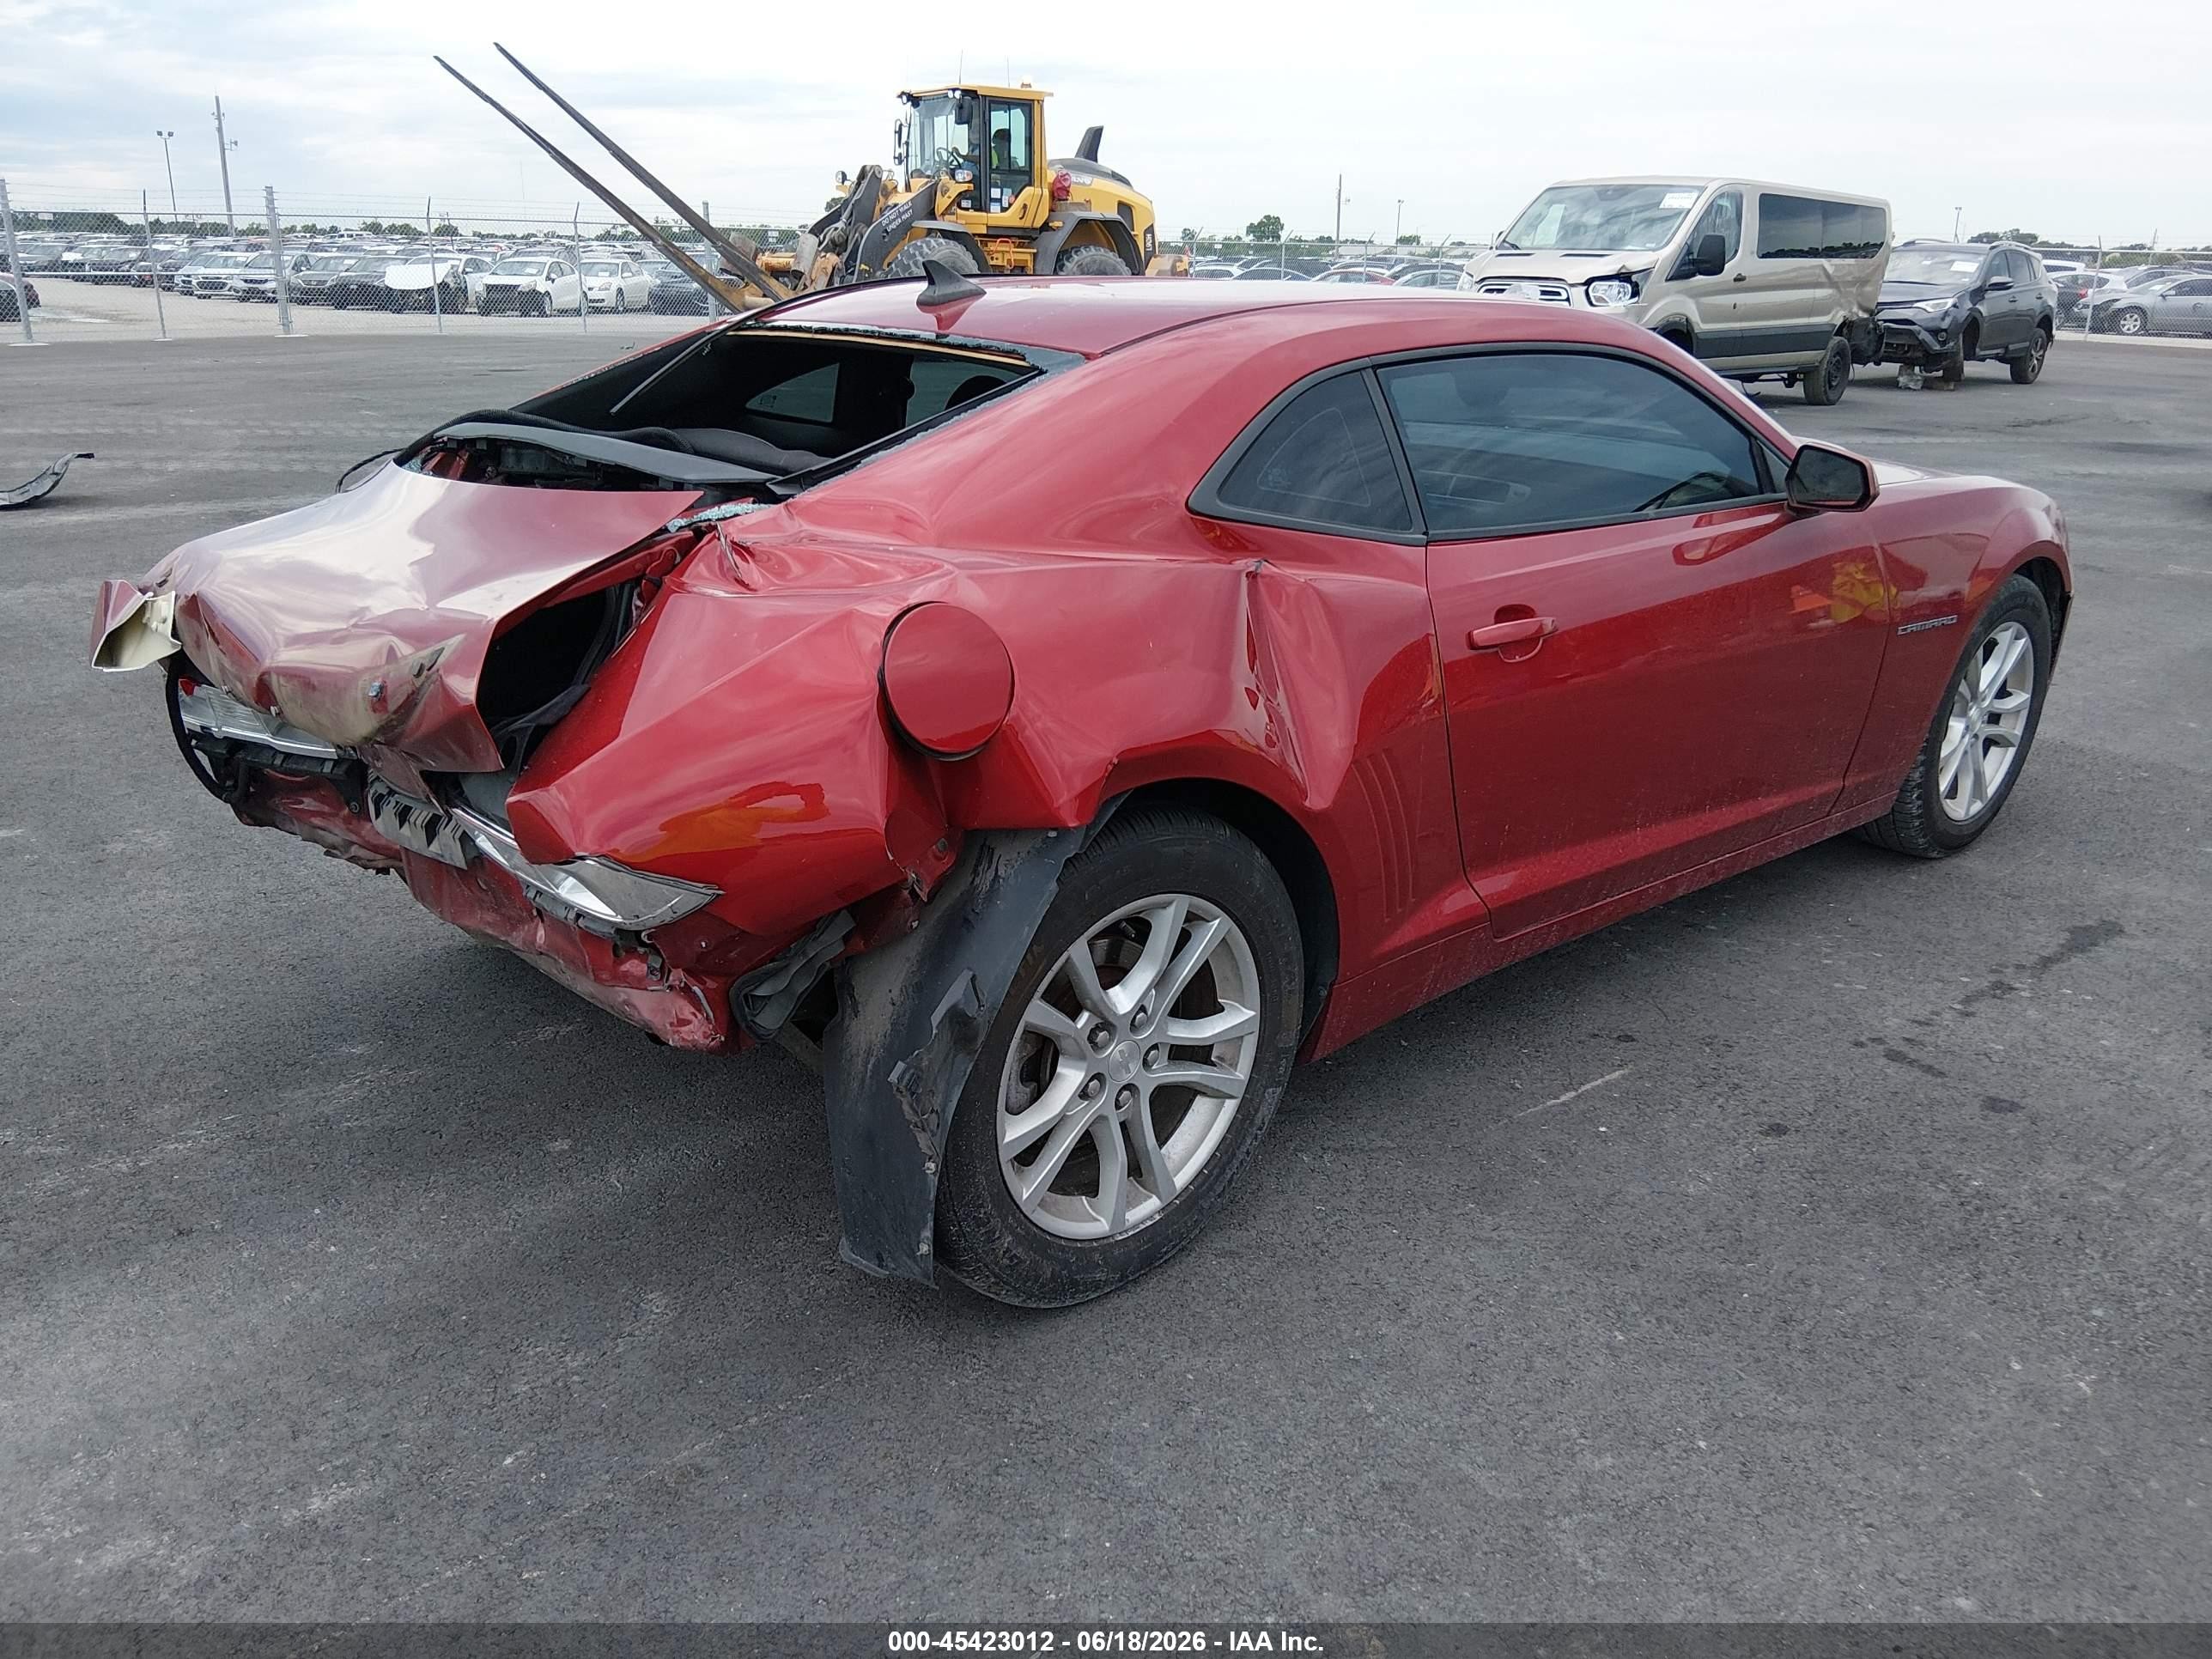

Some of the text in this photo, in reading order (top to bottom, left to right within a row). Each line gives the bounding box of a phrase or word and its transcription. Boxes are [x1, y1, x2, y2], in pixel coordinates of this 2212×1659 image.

[881, 200, 913, 227] DO NOT WALK
[886, 209, 913, 232] UNDER MAST
[1896, 614, 1959, 635] CAMARO
